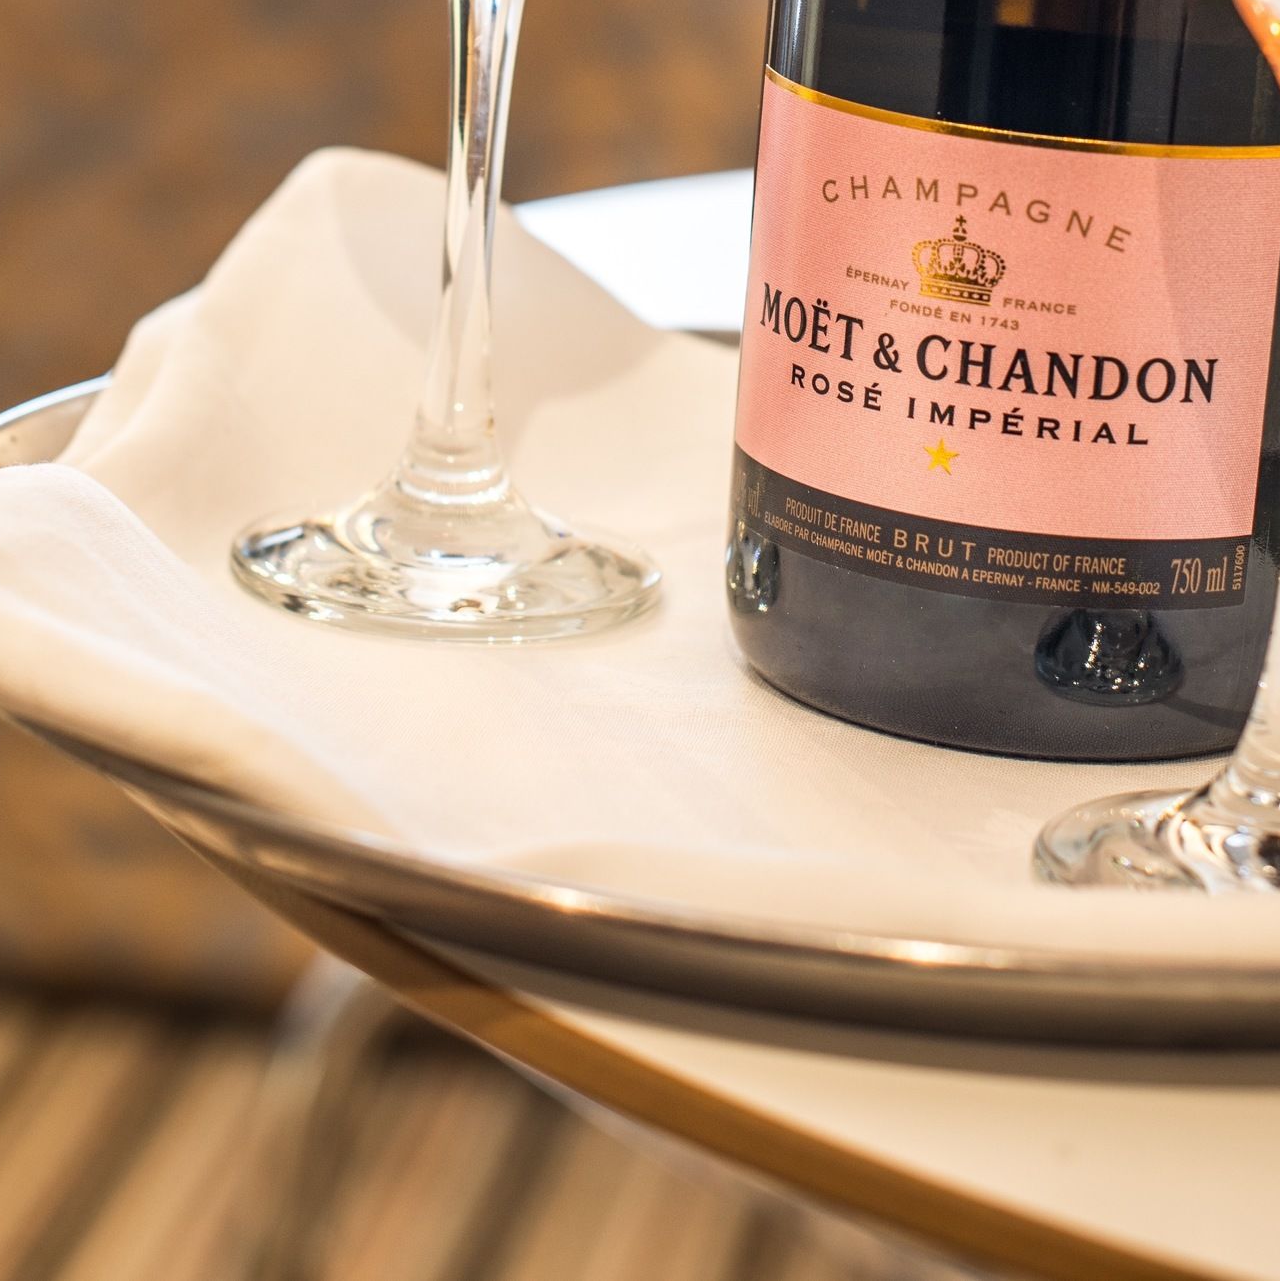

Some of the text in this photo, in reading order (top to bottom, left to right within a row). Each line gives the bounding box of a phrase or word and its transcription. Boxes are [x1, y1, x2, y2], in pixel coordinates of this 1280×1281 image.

[821, 174, 1133, 253] CHAMPAGNE
[845, 265, 1078, 316] ÉPERNAY FRANCE
[889, 298, 1021, 331] FONDÉ EN 1743
[759, 281, 1220, 406] MOËT & CHANDON
[790, 363, 1150, 446] ROSÉ IMPÉRIAL
[785, 497, 882, 544] PRODUIT DE FRANCE
[794, 524, 810, 543] PAR
[810, 530, 865, 559] CHAMPAGNE
[896, 555, 904, 568] &
[906, 557, 959, 579] CHANDON
[972, 569, 1025, 588] EPERNAY
[1035, 576, 1081, 592] FRANCE
[1091, 581, 1160, 595] NM-549-002
[893, 528, 977, 562] BRUT
[987, 548, 1127, 577] PRODUCT OF FRANCE
[1231, 544, 1245, 591] 5117600
[1170, 555, 1228, 595] 750 ml
